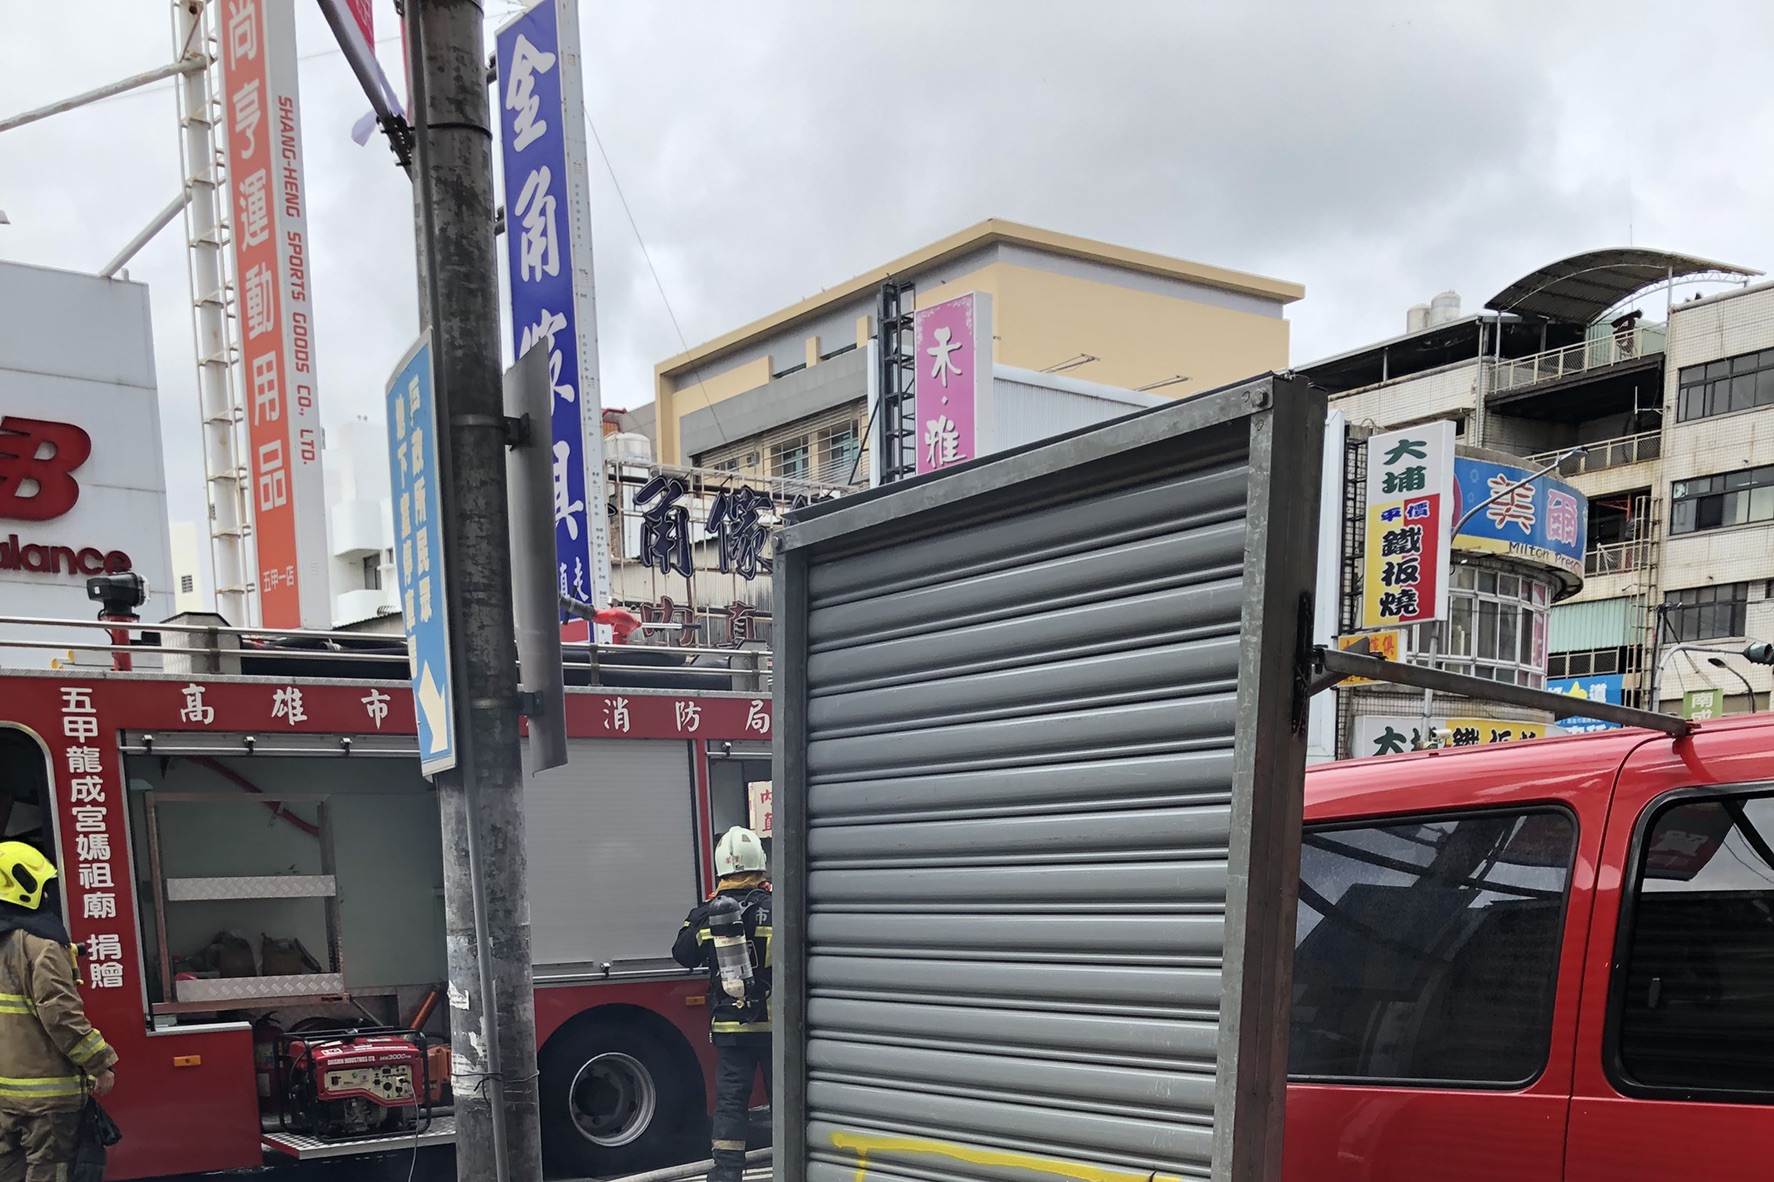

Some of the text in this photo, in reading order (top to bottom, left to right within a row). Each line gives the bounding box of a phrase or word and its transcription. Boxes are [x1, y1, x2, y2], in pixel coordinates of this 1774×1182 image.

[278, 95, 315, 465] SHANG-HENG SPORTS GOODS CO., LTD.
[1382, 439, 1428, 494] 大埔
[1380, 502, 1430, 522] 平價
[1380, 526, 1422, 618] 鐵板燒
[1508, 541, 1550, 560] Milton
[263, 564, 295, 593] 五甲一店
[603, 696, 771, 734] 消防局
[60, 686, 117, 919] 五甲龍成宮媽祖廟
[87, 933, 124, 990] 捐贈
